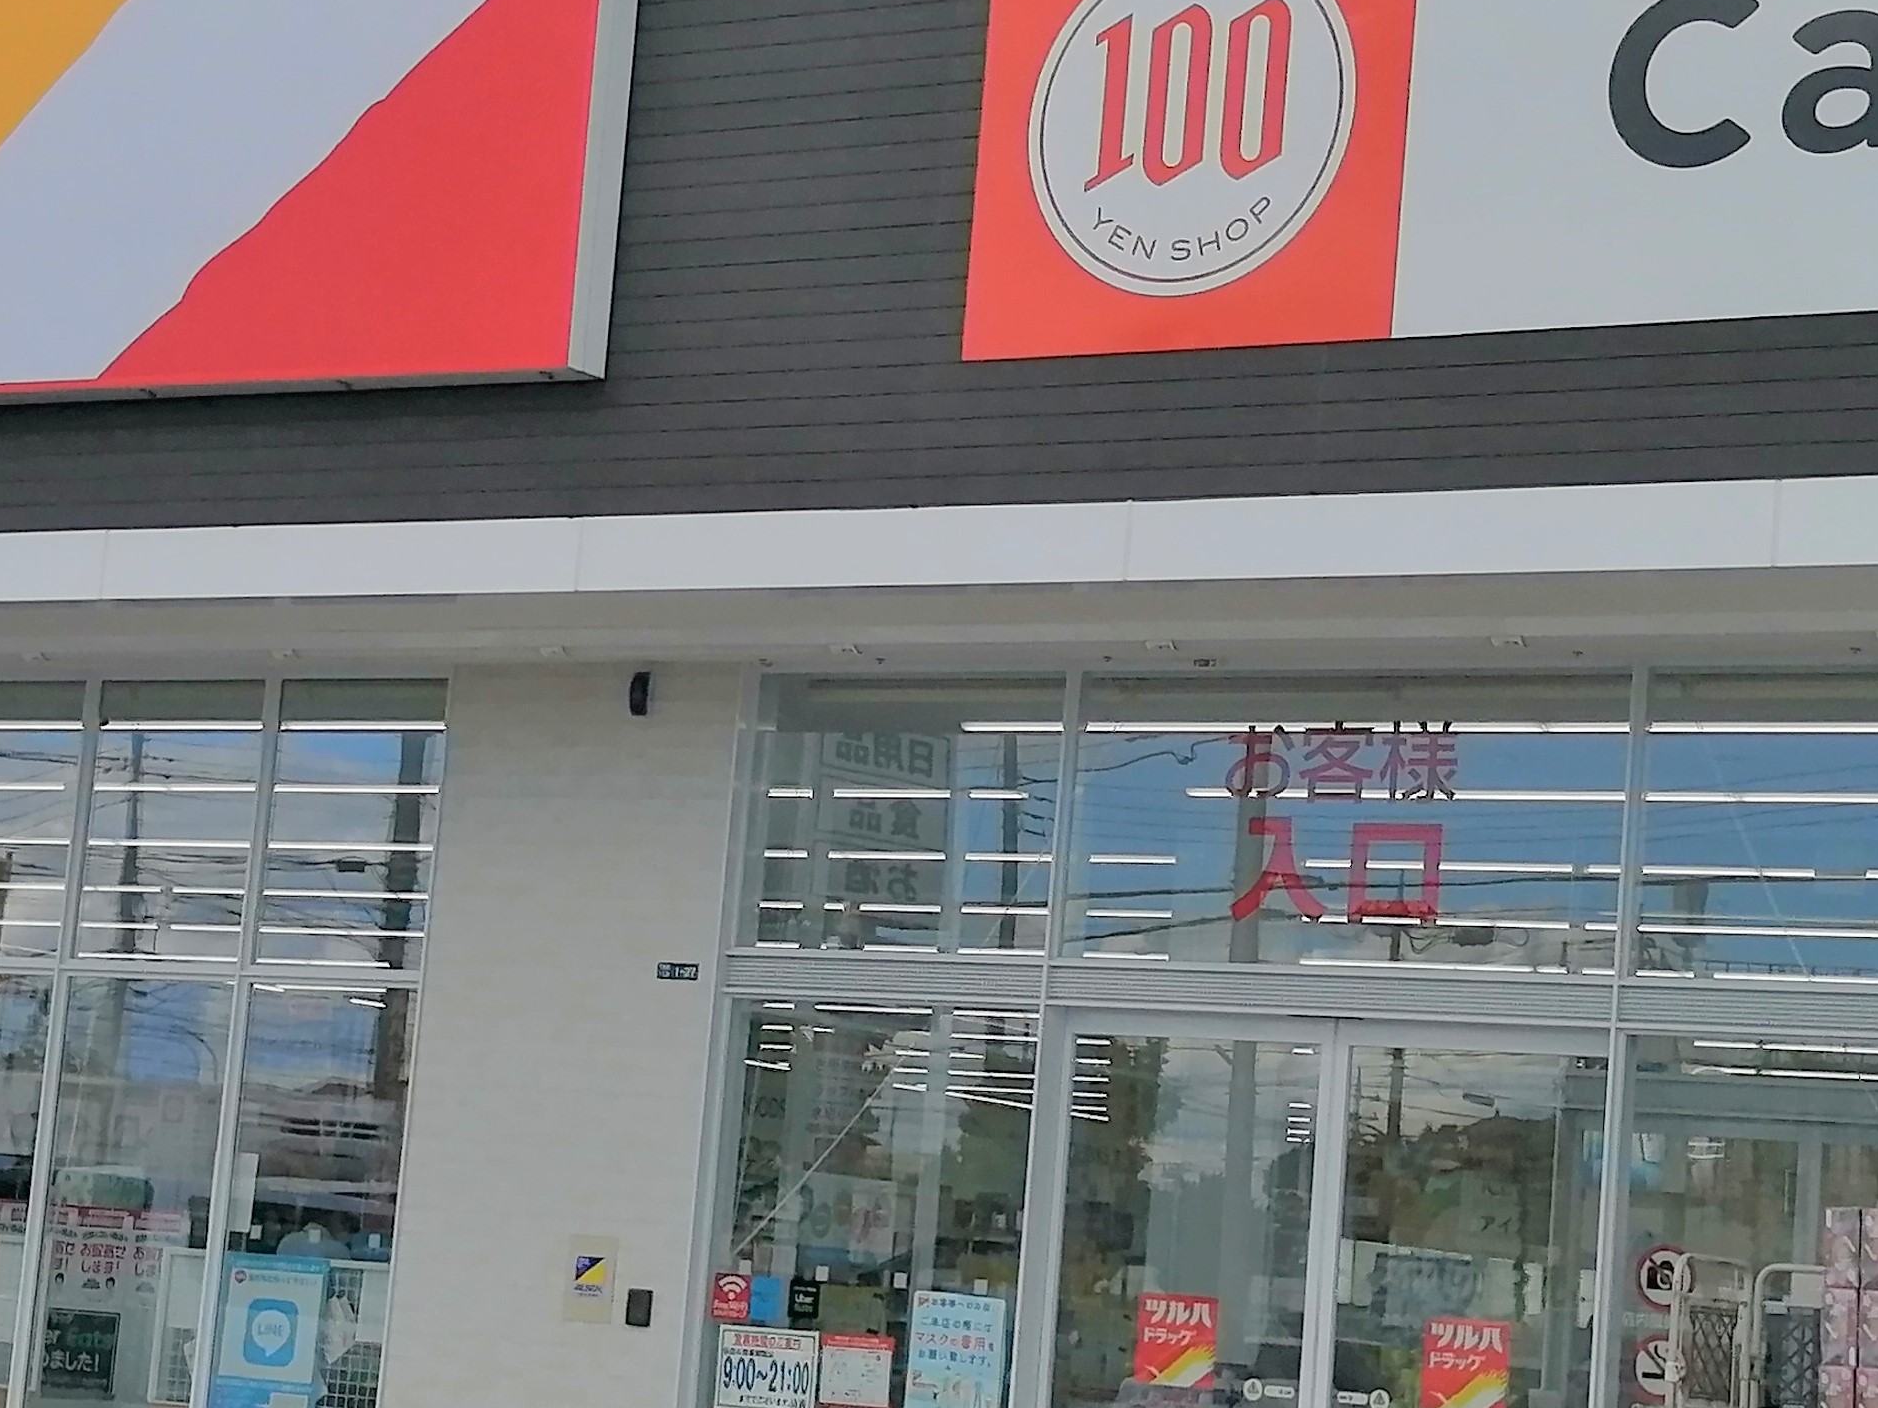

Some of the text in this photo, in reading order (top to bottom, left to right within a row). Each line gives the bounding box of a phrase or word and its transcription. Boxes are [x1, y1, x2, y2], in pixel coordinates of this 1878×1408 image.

[1088, 194, 1274, 262] YEN SHOP
[1225, 721, 1459, 803] お客様
[1230, 816, 1444, 923] 入口
[1144, 1298, 1212, 1329] ツルハ
[1143, 1326, 1197, 1346] ドラッグ
[1430, 1322, 1503, 1353] ツルハ
[1428, 1351, 1486, 1371] ドラッグ
